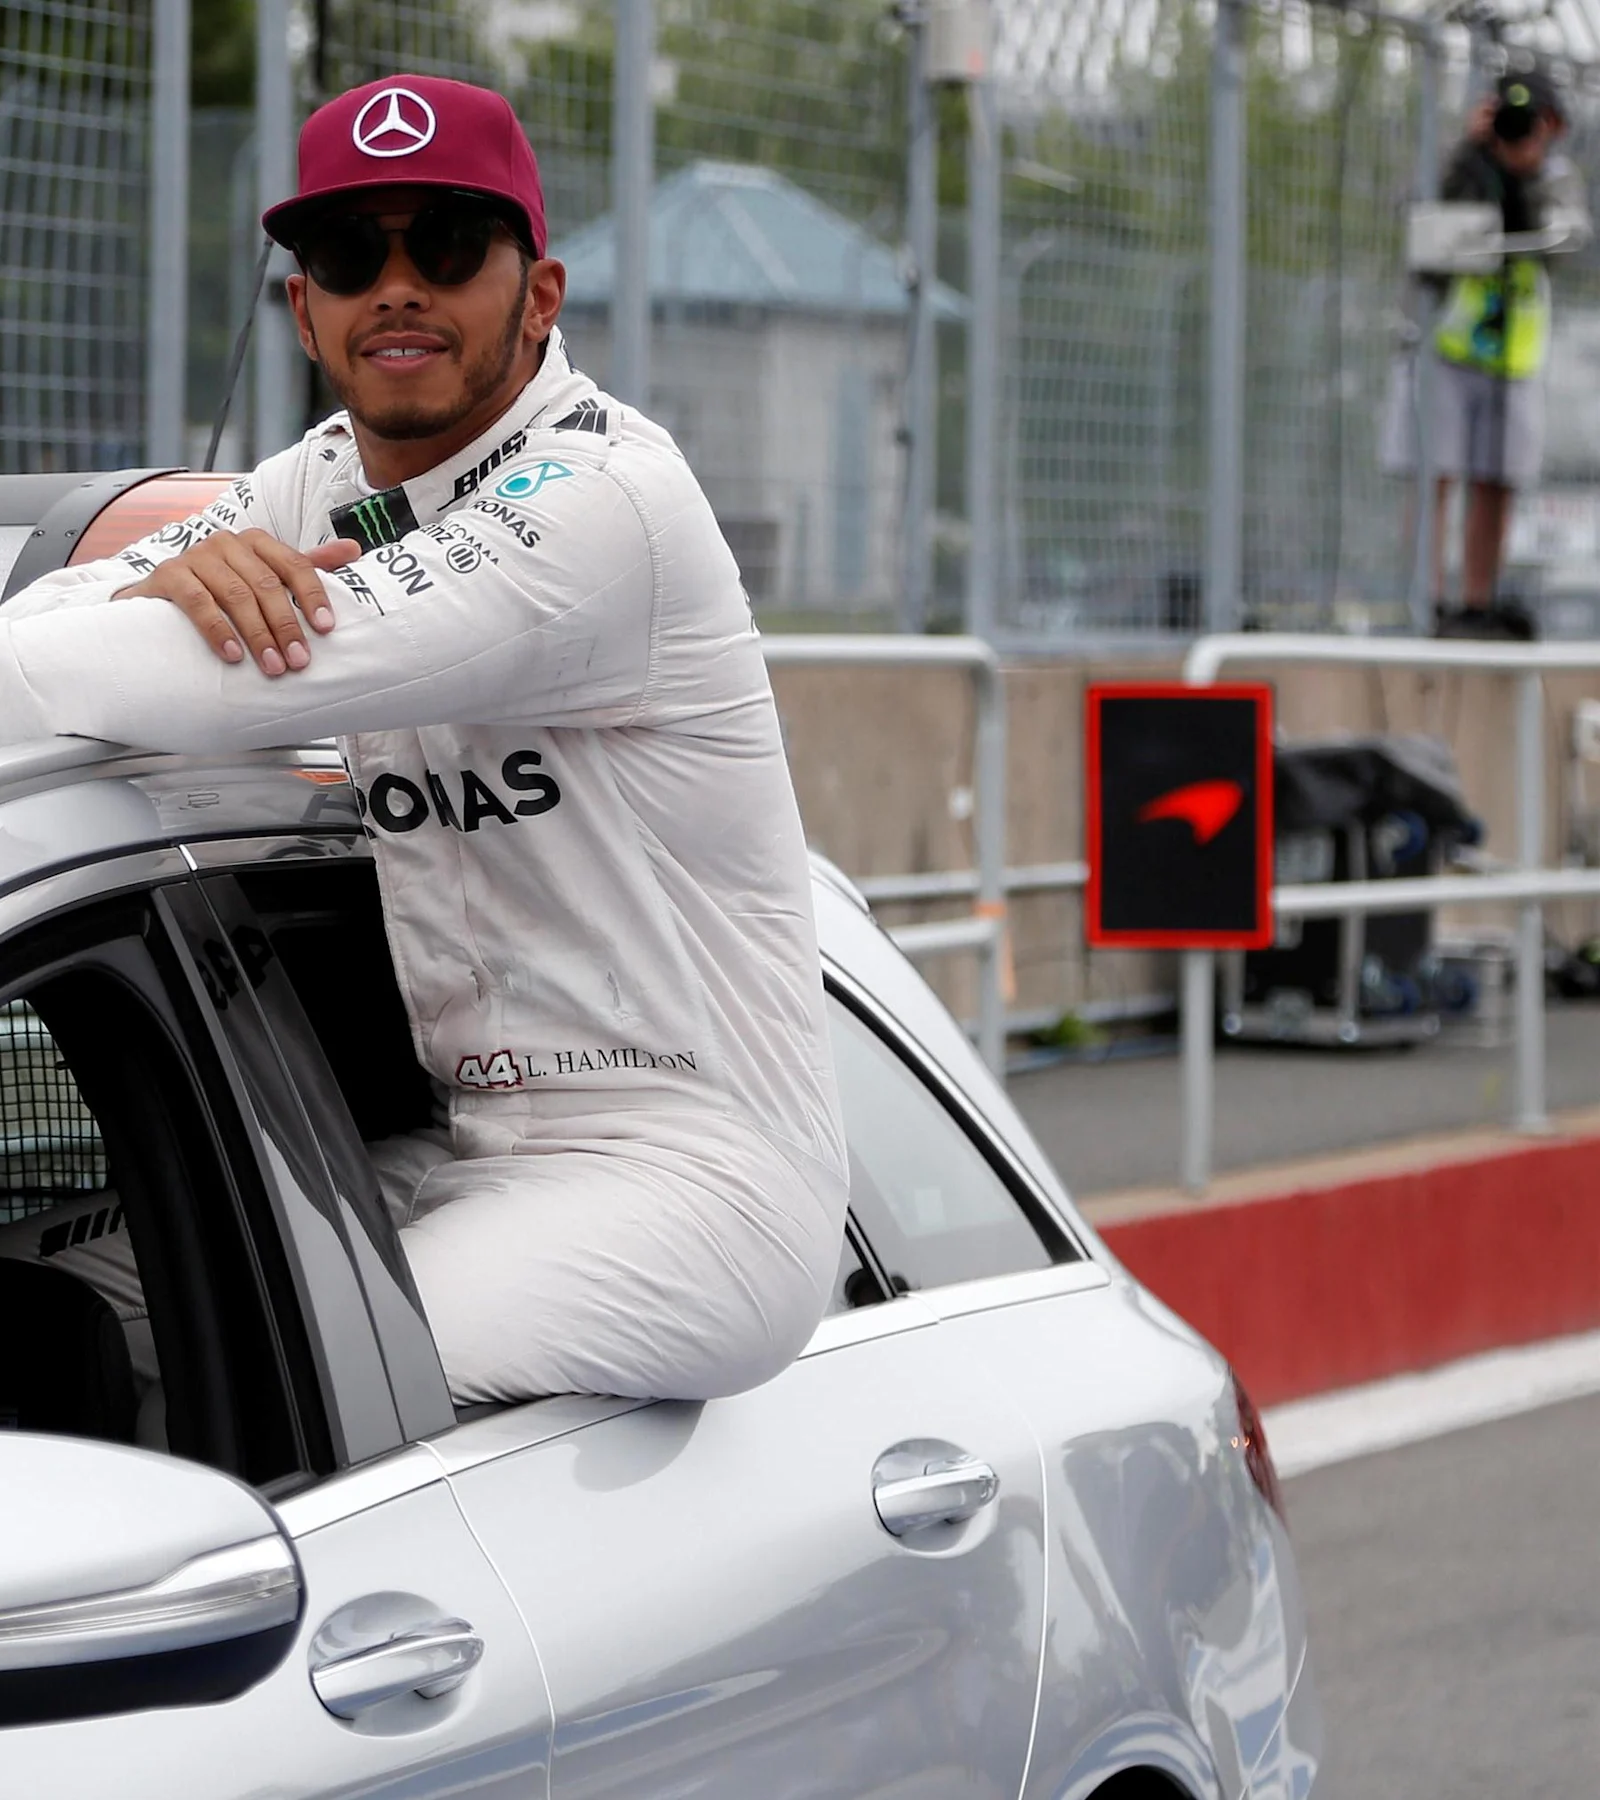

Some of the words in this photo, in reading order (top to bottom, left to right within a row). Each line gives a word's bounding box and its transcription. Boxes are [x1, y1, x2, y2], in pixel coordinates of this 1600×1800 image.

[437, 430, 528, 512] BOS
[355, 750, 561, 840] ONAS
[455, 1049, 524, 1088] 44
[524, 1055, 547, 1077] L.
[554, 1048, 698, 1075] HAMILTON
